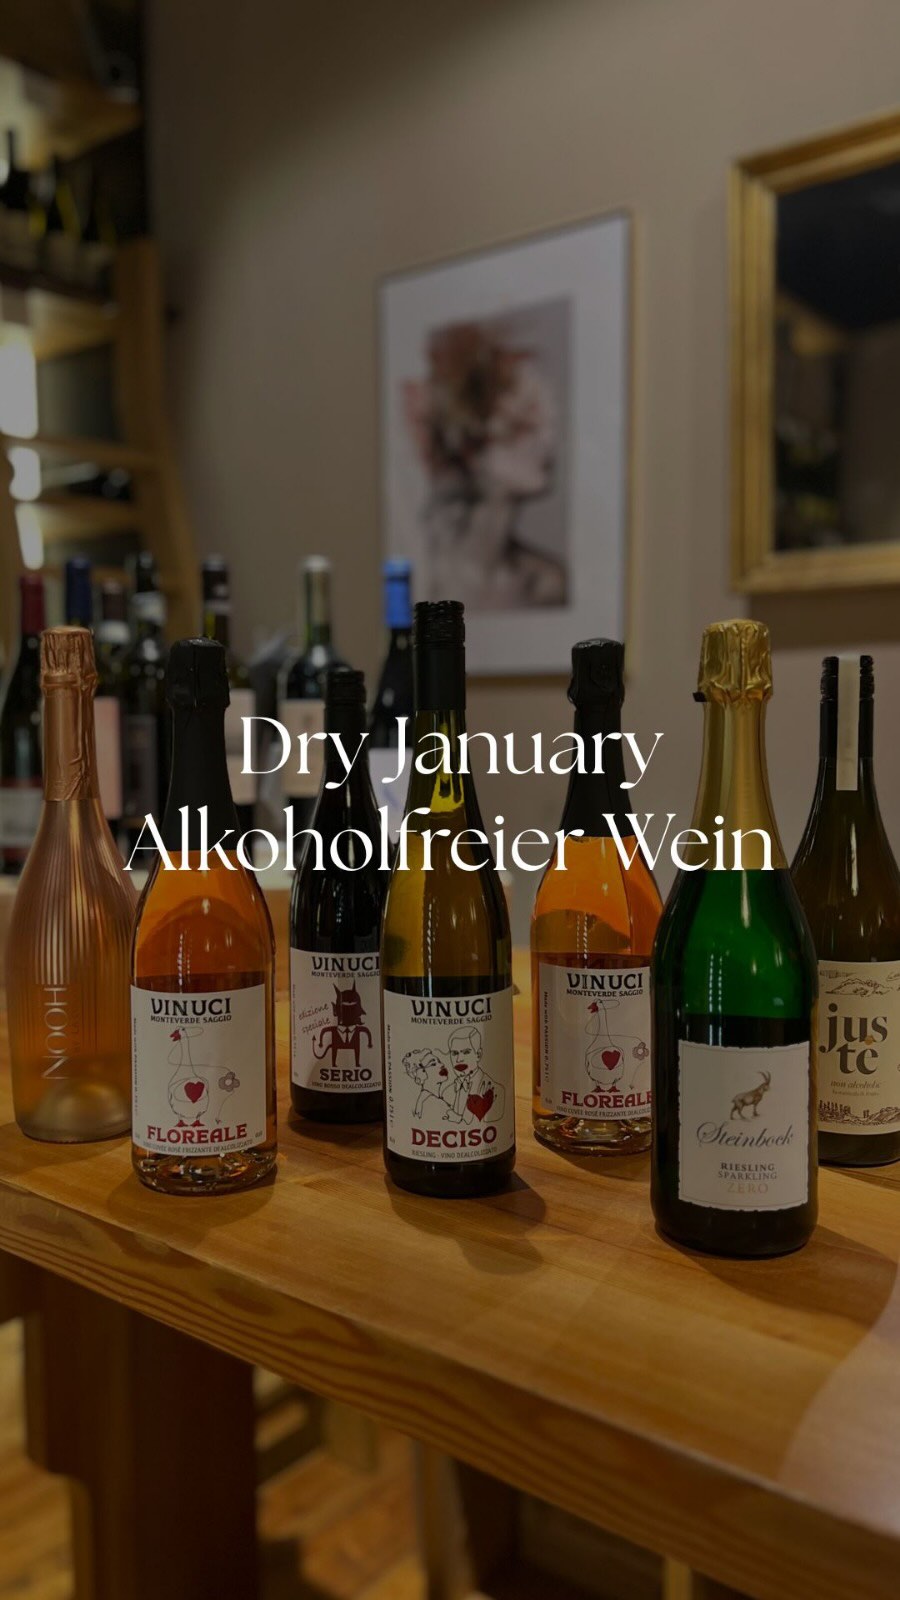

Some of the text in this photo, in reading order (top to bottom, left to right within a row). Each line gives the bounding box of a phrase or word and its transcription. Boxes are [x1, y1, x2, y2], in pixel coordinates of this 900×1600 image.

[312, 956, 380, 972] VINUCI
[567, 973, 642, 989] VINUCI
[567, 989, 616, 997] MONTEVERDE
[151, 998, 231, 1016] VINUCI
[411, 997, 491, 1017] VINUCI
[151, 1015, 232, 1024] MONTEVERDE SAGGIO
[411, 1014, 492, 1025] MONTEVERDE SAGGIO
[41, 987, 69, 1079] NOOH
[320, 1069, 372, 1081] SERIO
[147, 1123, 248, 1145] FLOREALE
[411, 1125, 497, 1148] DECISO
[696, 1121, 794, 1148] Steinbock
[720, 1162, 776, 1172] RIESLING
[718, 1170, 778, 1181] SPARKLING
[727, 1182, 769, 1194] ZERO
